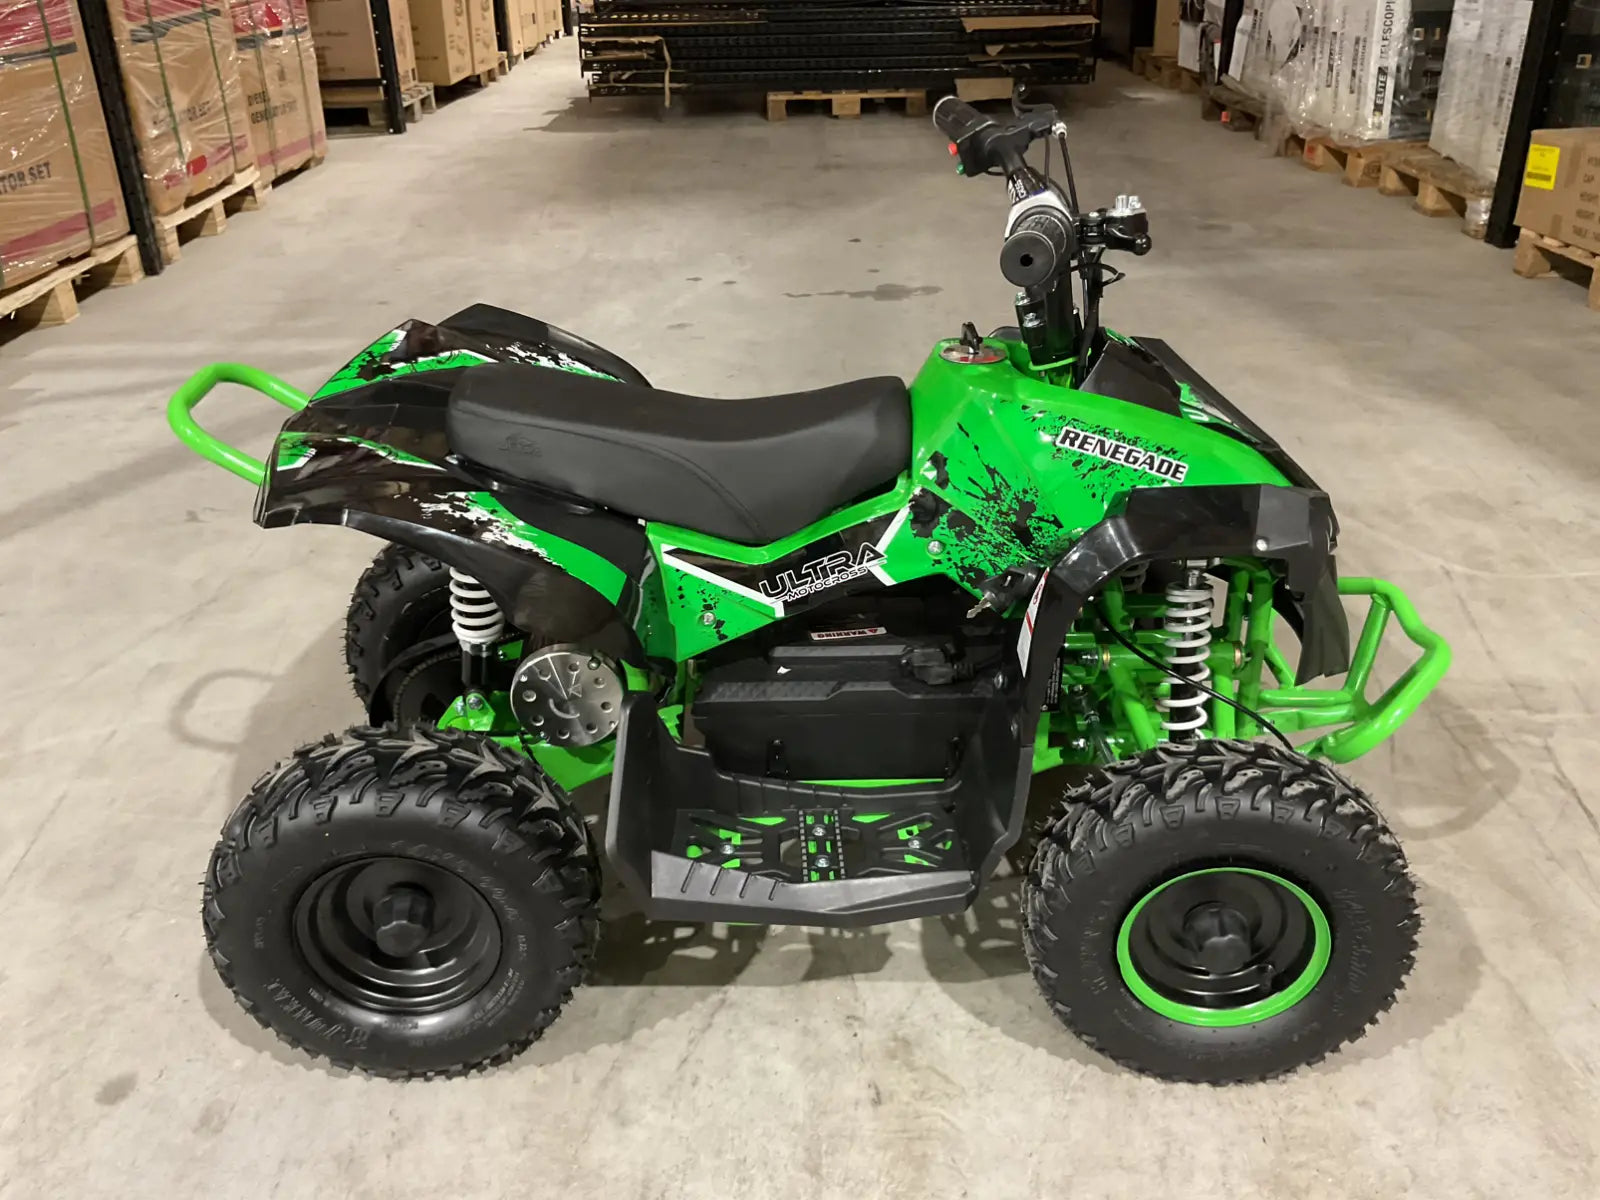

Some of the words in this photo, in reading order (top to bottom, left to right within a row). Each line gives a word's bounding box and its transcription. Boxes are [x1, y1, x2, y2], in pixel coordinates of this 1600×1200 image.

[0, 171, 28, 195] TOR
[28, 161, 52, 181] SET
[1058, 428, 1187, 481] RENEGADE
[759, 542, 887, 600] ULTRA
[787, 565, 868, 602] MOTOCROSS
[816, 629, 868, 639] WARNING
